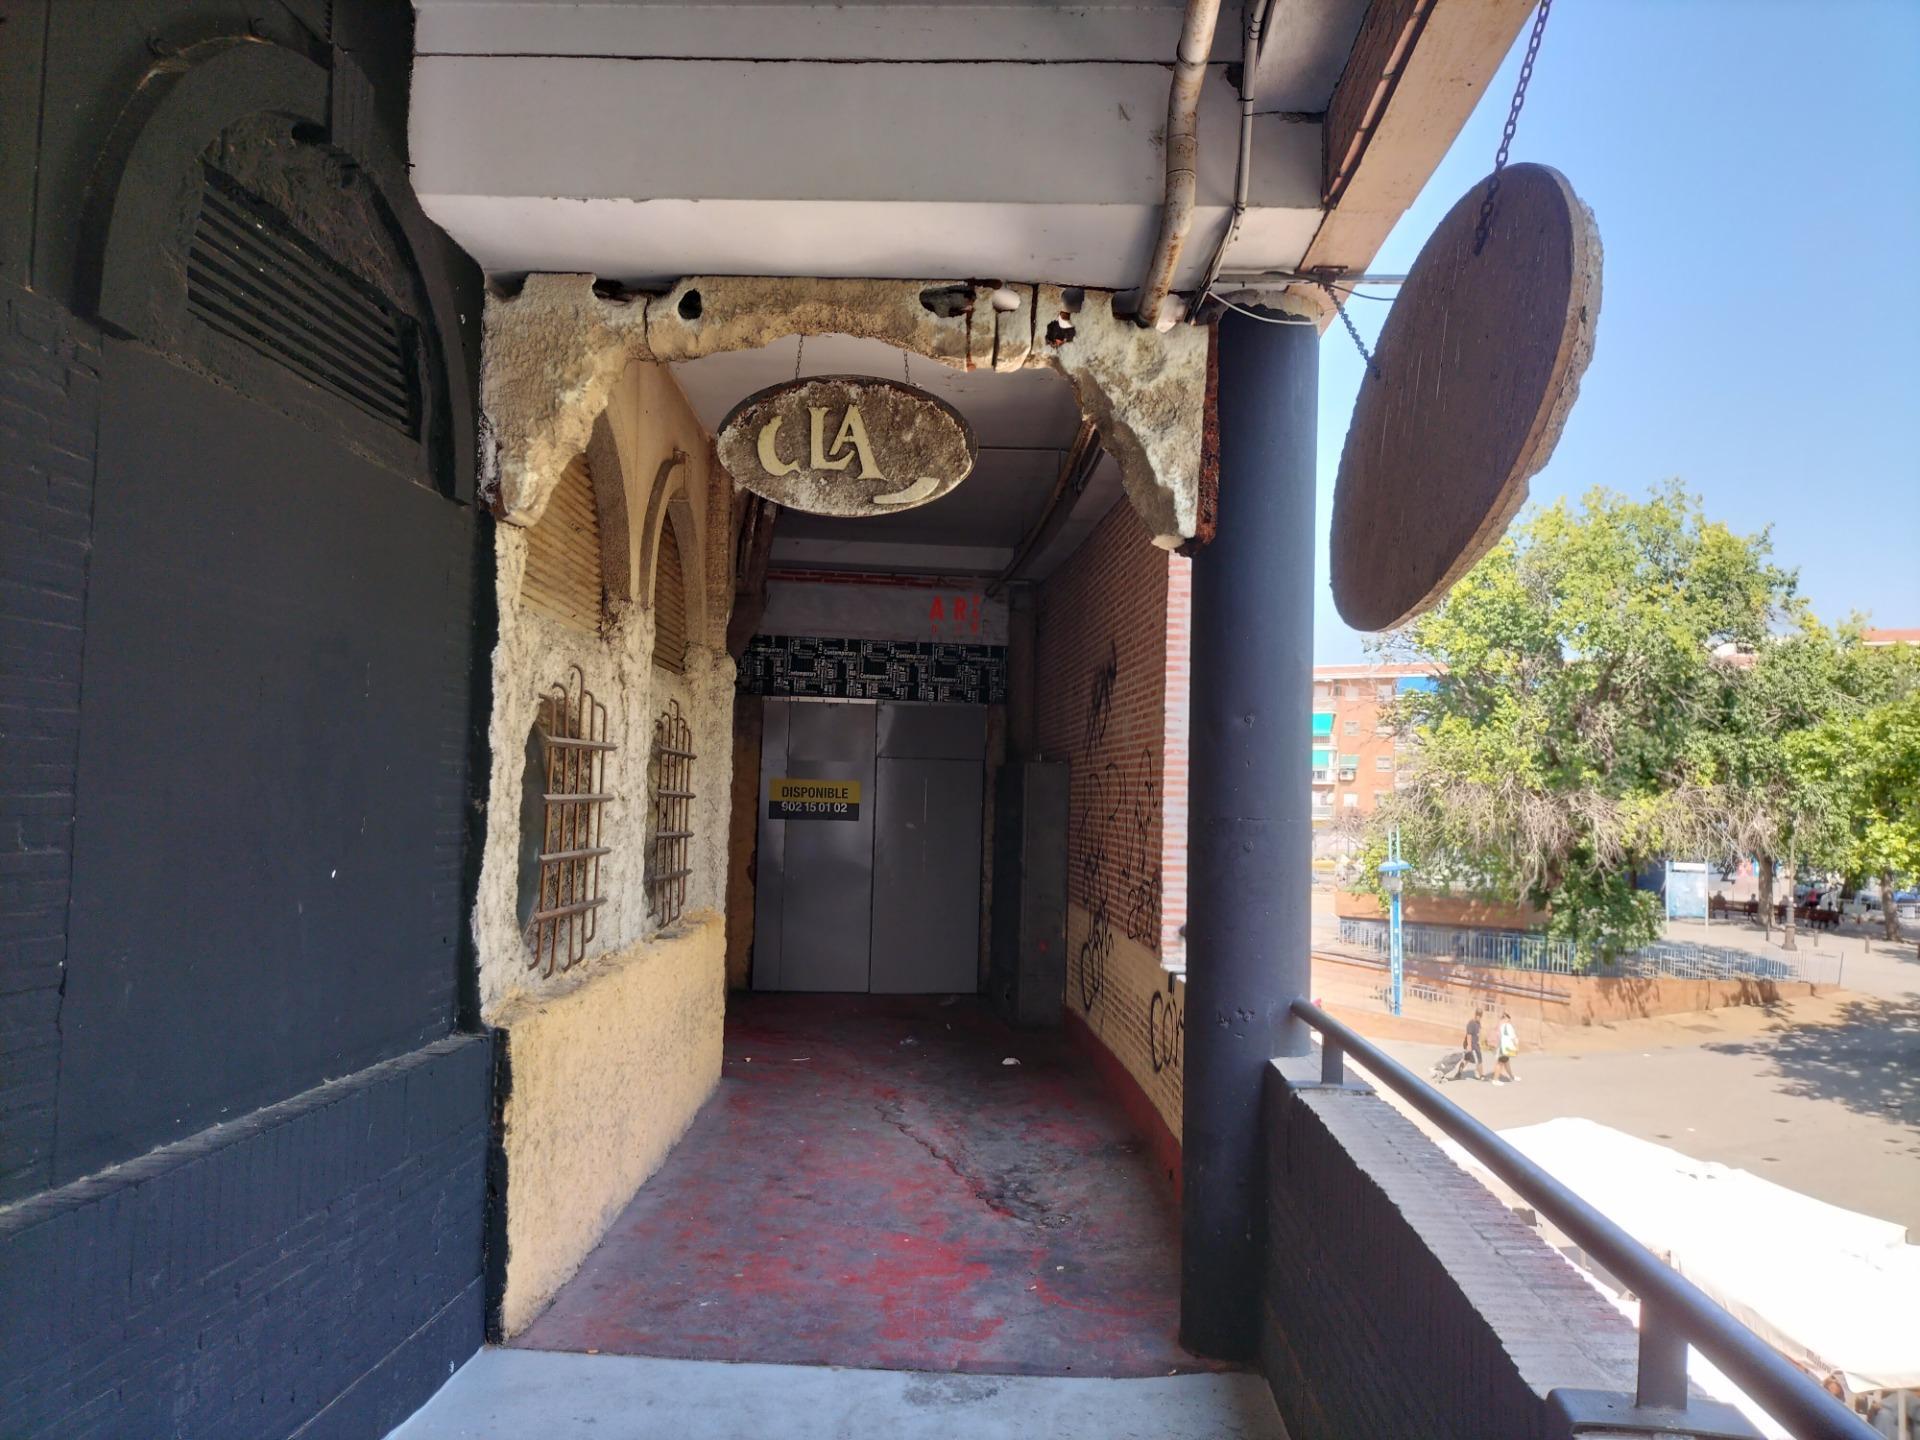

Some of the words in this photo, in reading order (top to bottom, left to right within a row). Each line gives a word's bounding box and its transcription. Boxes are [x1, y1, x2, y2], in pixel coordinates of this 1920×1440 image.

[782, 787, 848, 798] DISPONIBLE
[781, 802, 802, 812] 902
[805, 803, 817, 812] 15
[818, 803, 831, 812] 01
[833, 803, 847, 812] 02
